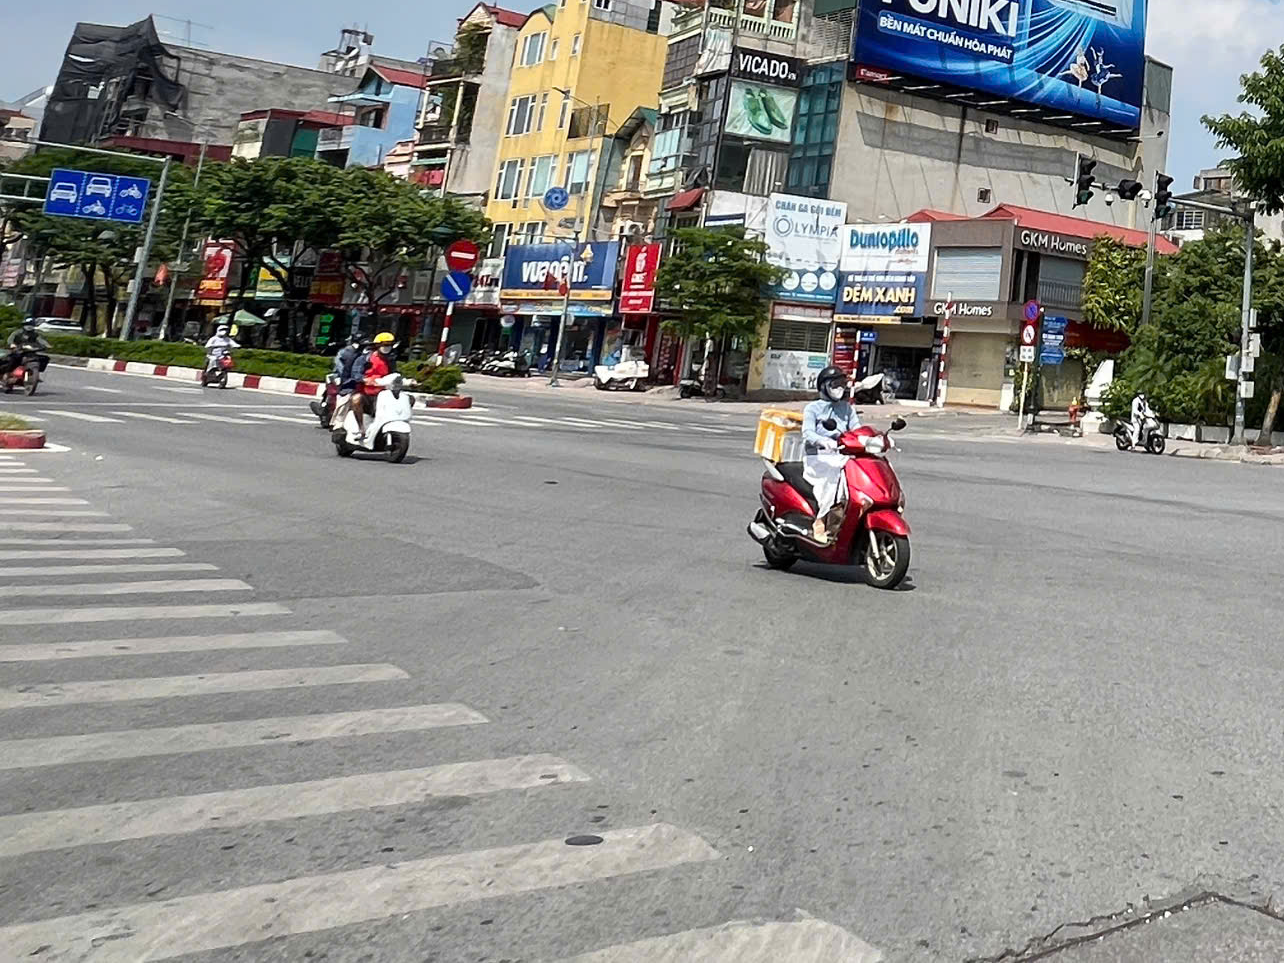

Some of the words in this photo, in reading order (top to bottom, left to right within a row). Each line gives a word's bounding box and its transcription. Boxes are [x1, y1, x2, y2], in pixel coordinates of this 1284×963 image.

[879, 15, 902, 32] BỀN
[903, 21, 927, 37] MÁT
[927, 29, 963, 48] CHUẨN
[964, 37, 987, 54] HÒA
[988, 44, 1013, 60] PHÁT
[850, 227, 919, 252] Dunlopillo
[1021, 230, 1048, 248] GKM
[1050, 236, 1087, 255] Homes
[874, 286, 916, 303] XANH
[958, 302, 993, 316] Homes
